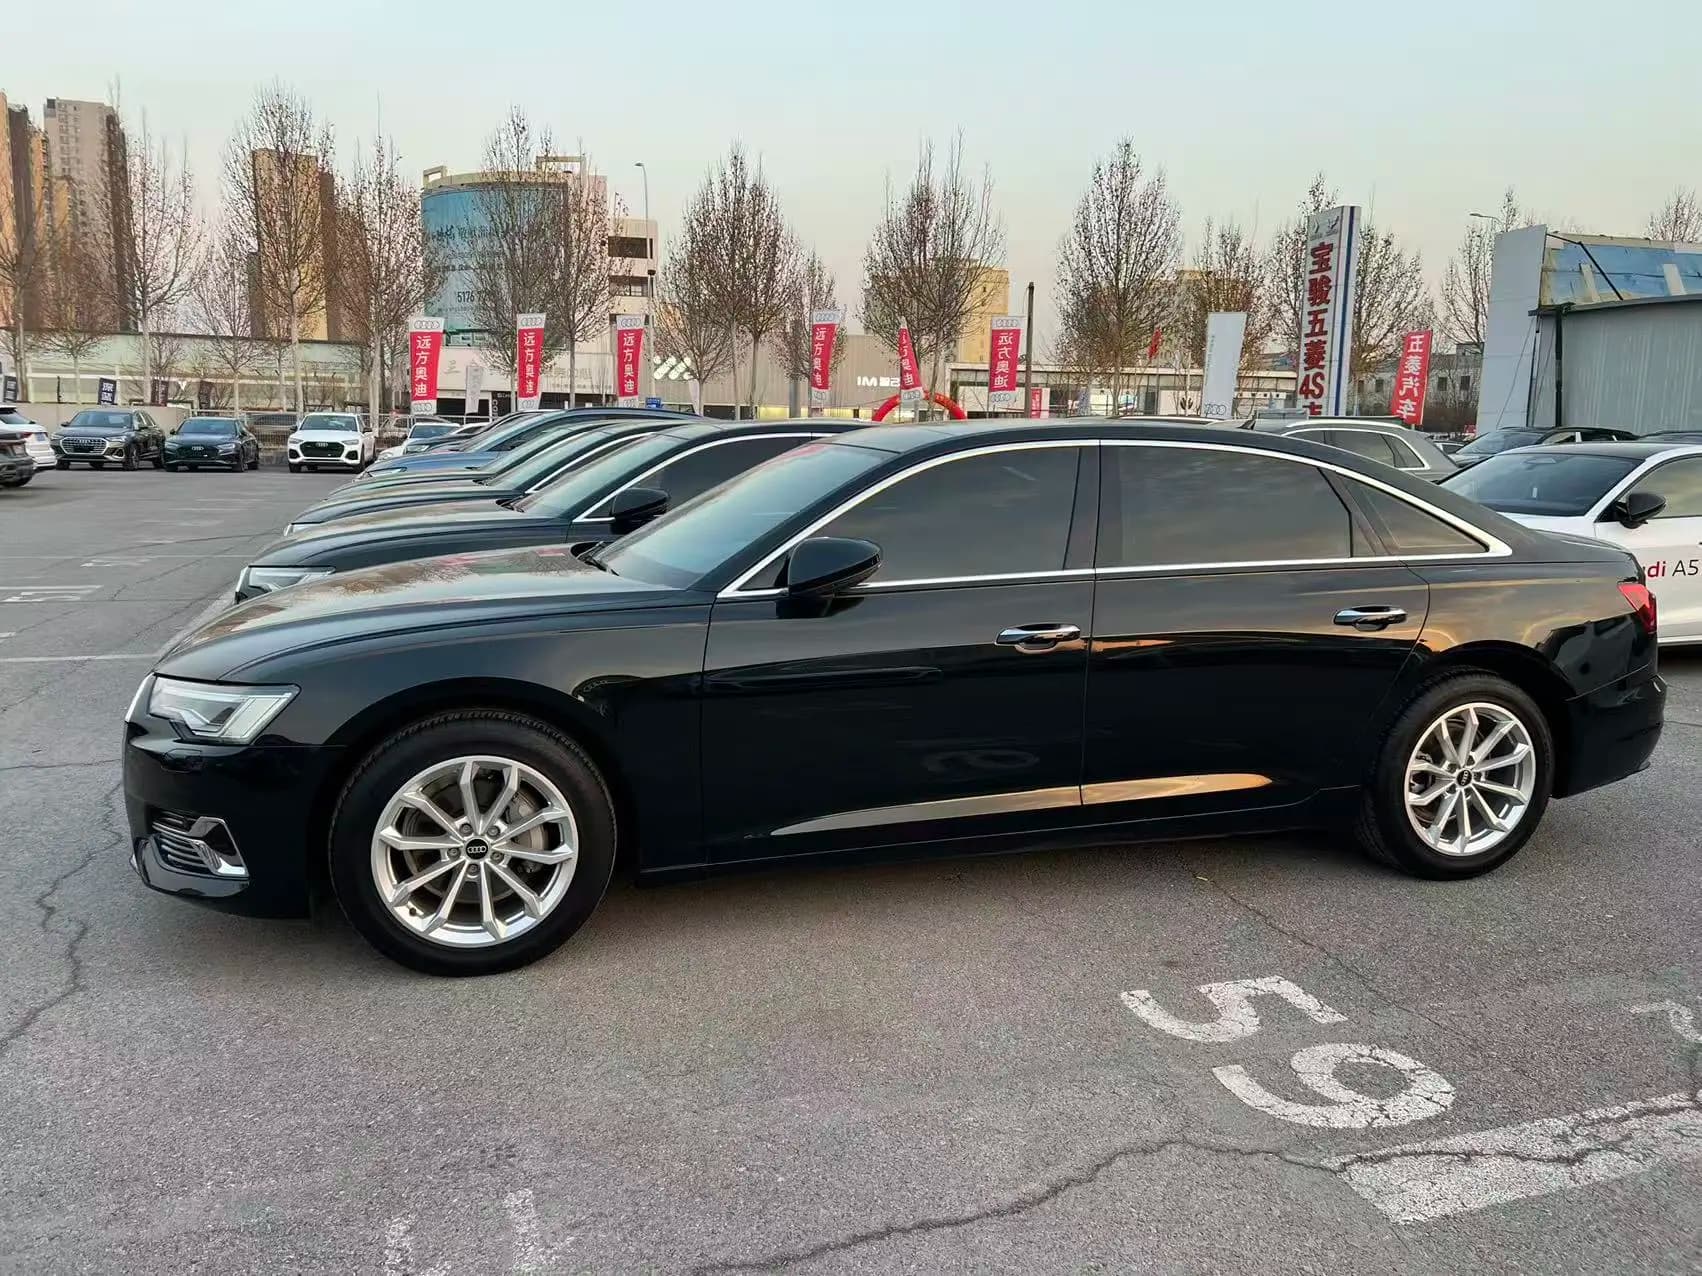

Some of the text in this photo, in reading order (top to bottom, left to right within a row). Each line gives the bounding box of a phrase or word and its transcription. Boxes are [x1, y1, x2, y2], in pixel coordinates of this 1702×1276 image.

[414, 335, 432, 397] 远方奥迪
[523, 332, 535, 394] 远方奥迪
[623, 333, 635, 393] 远方奥迪
[1643, 559, 1699, 578] di A5
